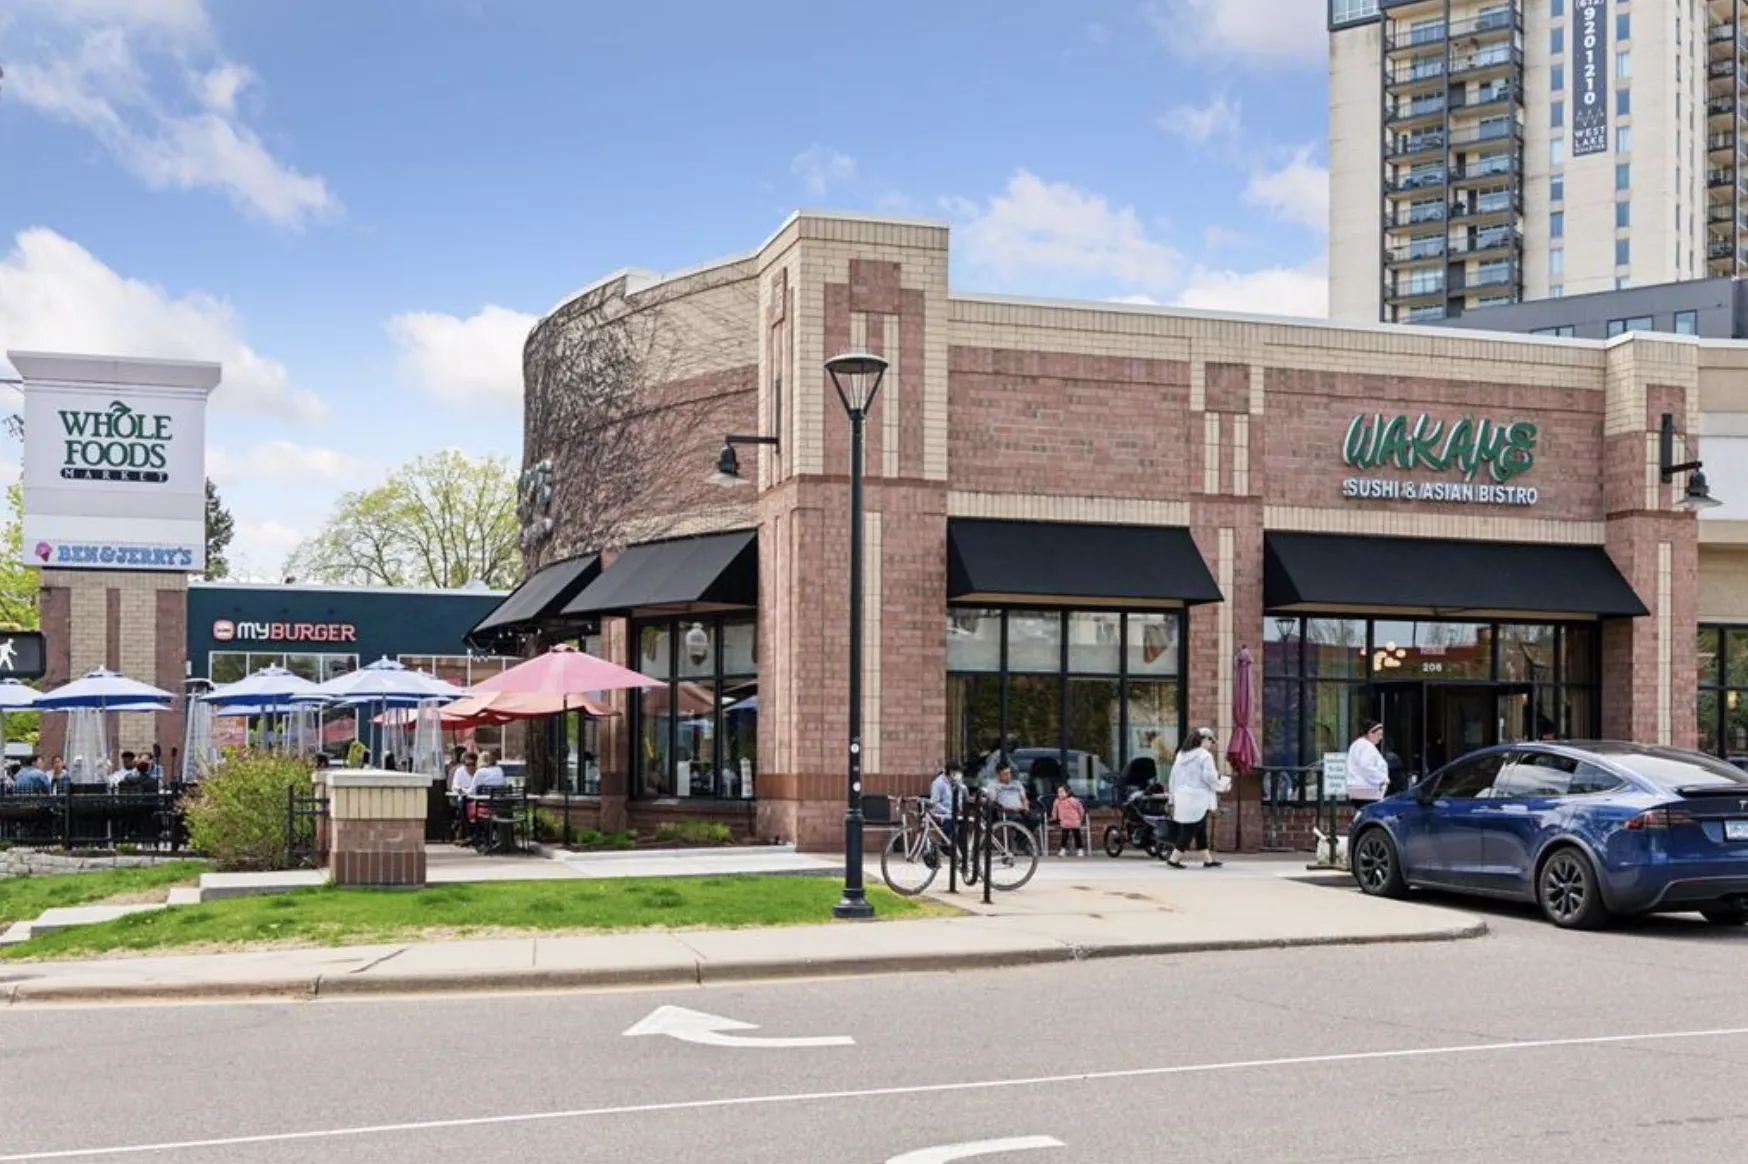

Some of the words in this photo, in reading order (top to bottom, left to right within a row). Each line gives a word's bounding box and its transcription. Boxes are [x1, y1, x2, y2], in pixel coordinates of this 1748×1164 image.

[58, 410, 172, 440] WHOLE
[64, 440, 166, 469] FOODS
[1343, 413, 1537, 482] WAKAME
[63, 469, 165, 482] MARKET
[1344, 477, 1398, 498] SUSHI
[1404, 481, 1416, 499] &
[1420, 482, 1474, 502] ASIAN
[1477, 484, 1538, 505] BISTRO
